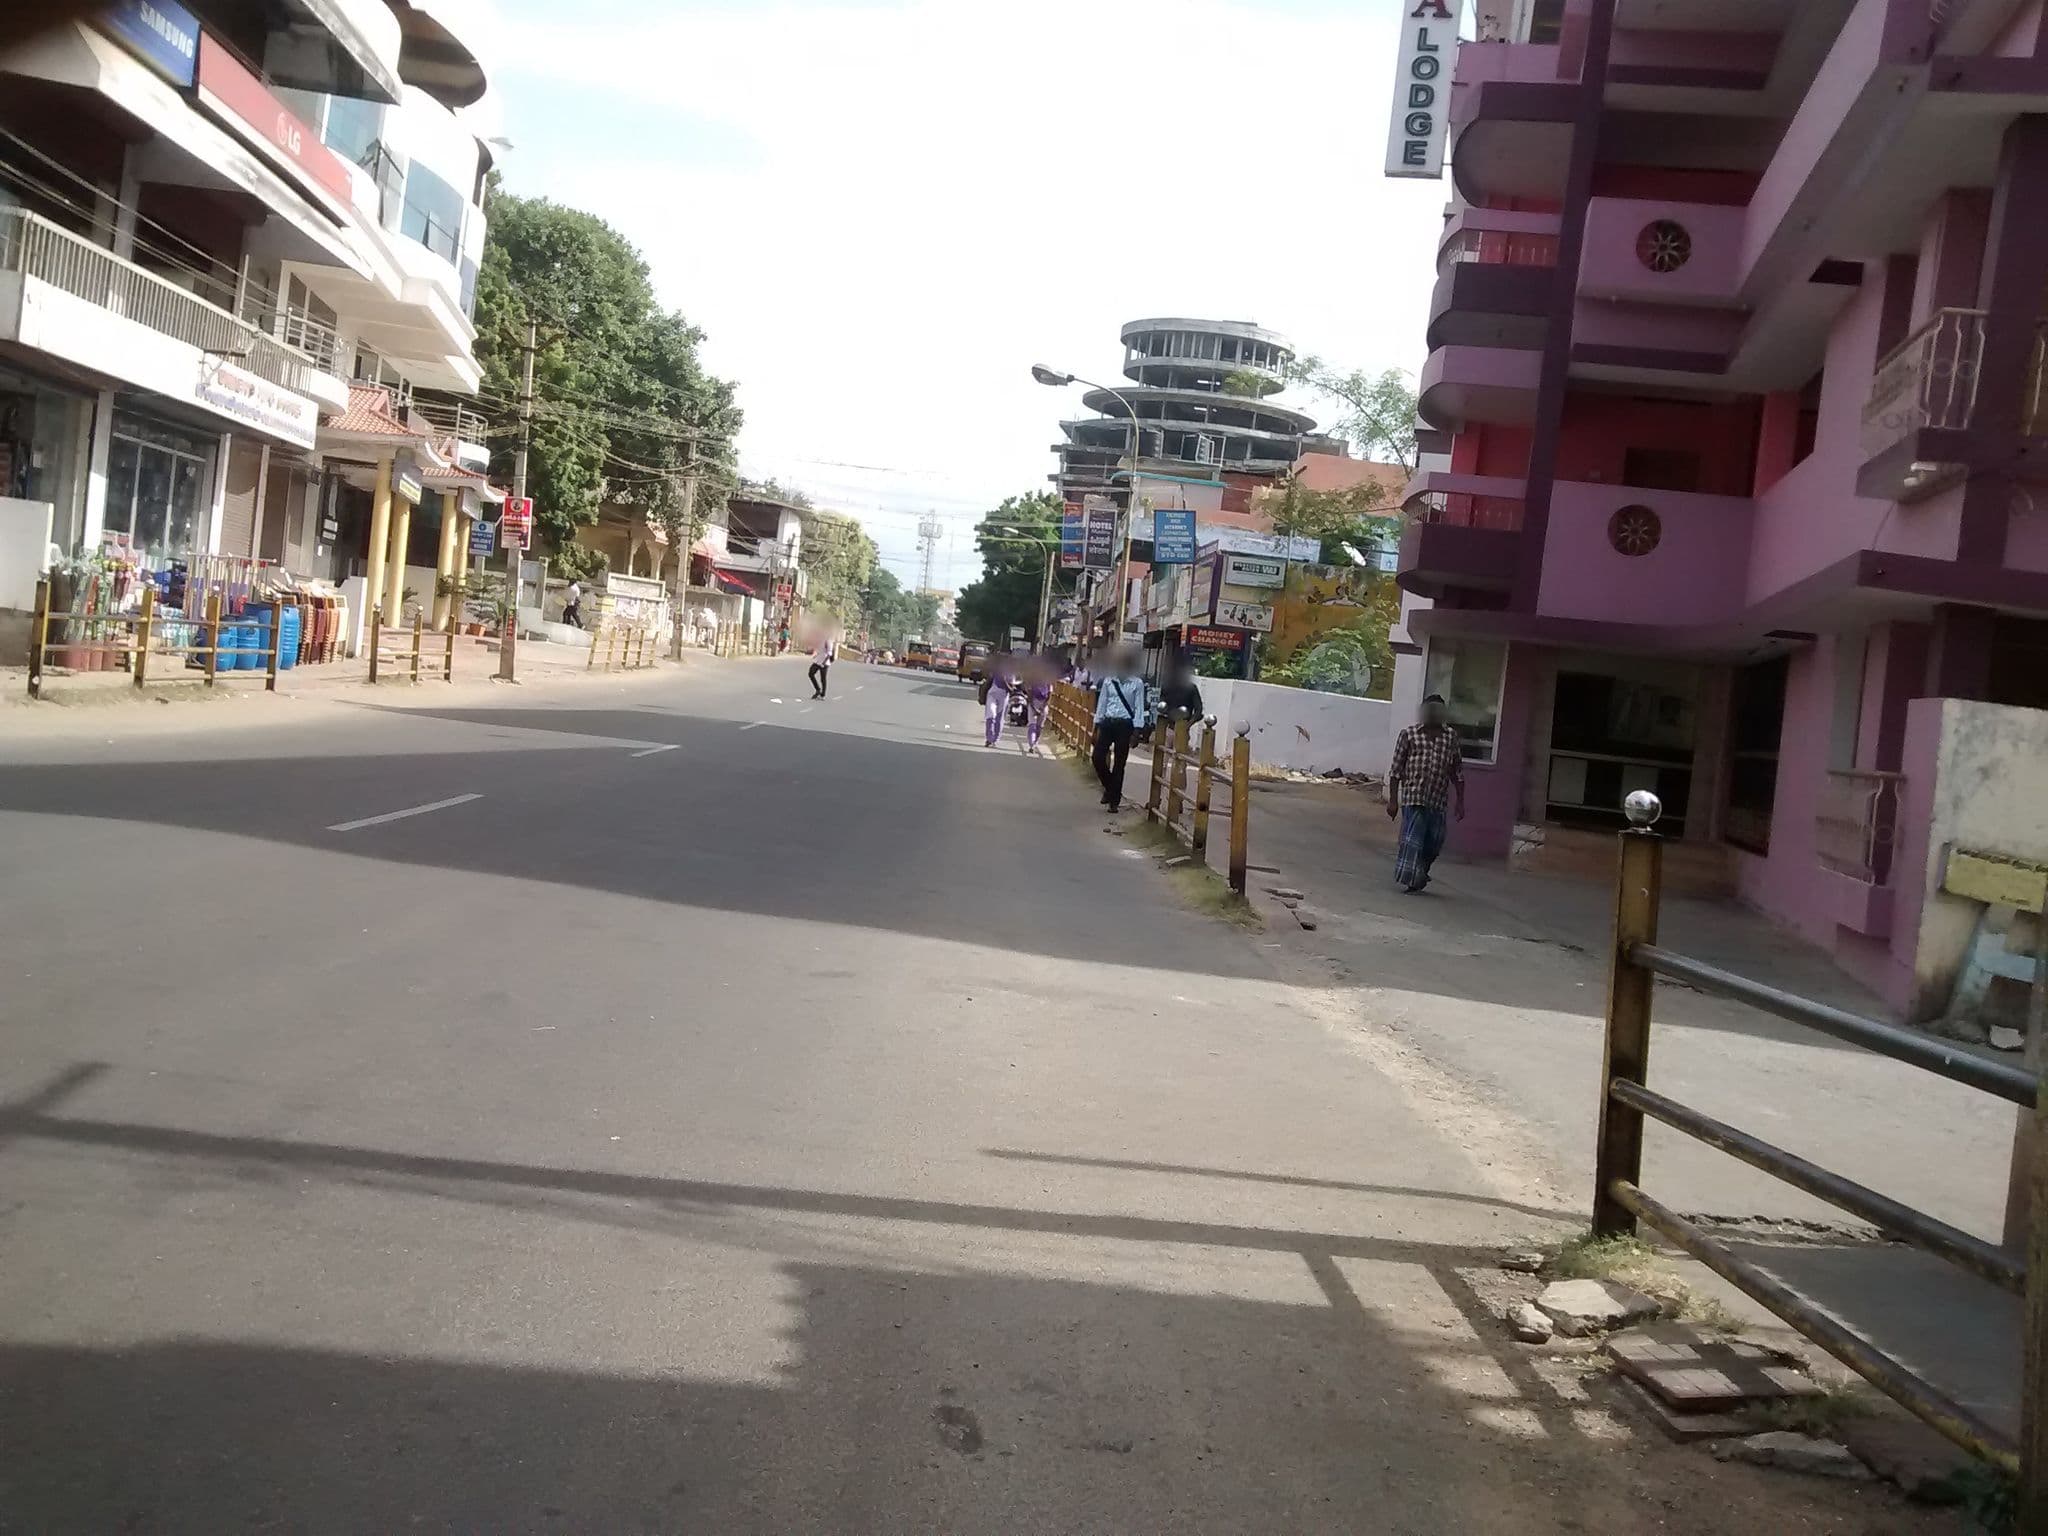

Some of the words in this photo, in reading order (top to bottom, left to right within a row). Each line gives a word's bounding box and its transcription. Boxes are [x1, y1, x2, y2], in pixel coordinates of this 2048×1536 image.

[140, 0, 194, 58] SAMSUNG
[1403, 28, 1440, 165] LODGE
[288, 125, 301, 155] LG
[1090, 521, 1113, 530] HOTEL
[1190, 635, 1240, 647] CHANGER
[1197, 629, 1235, 639] MONEY
